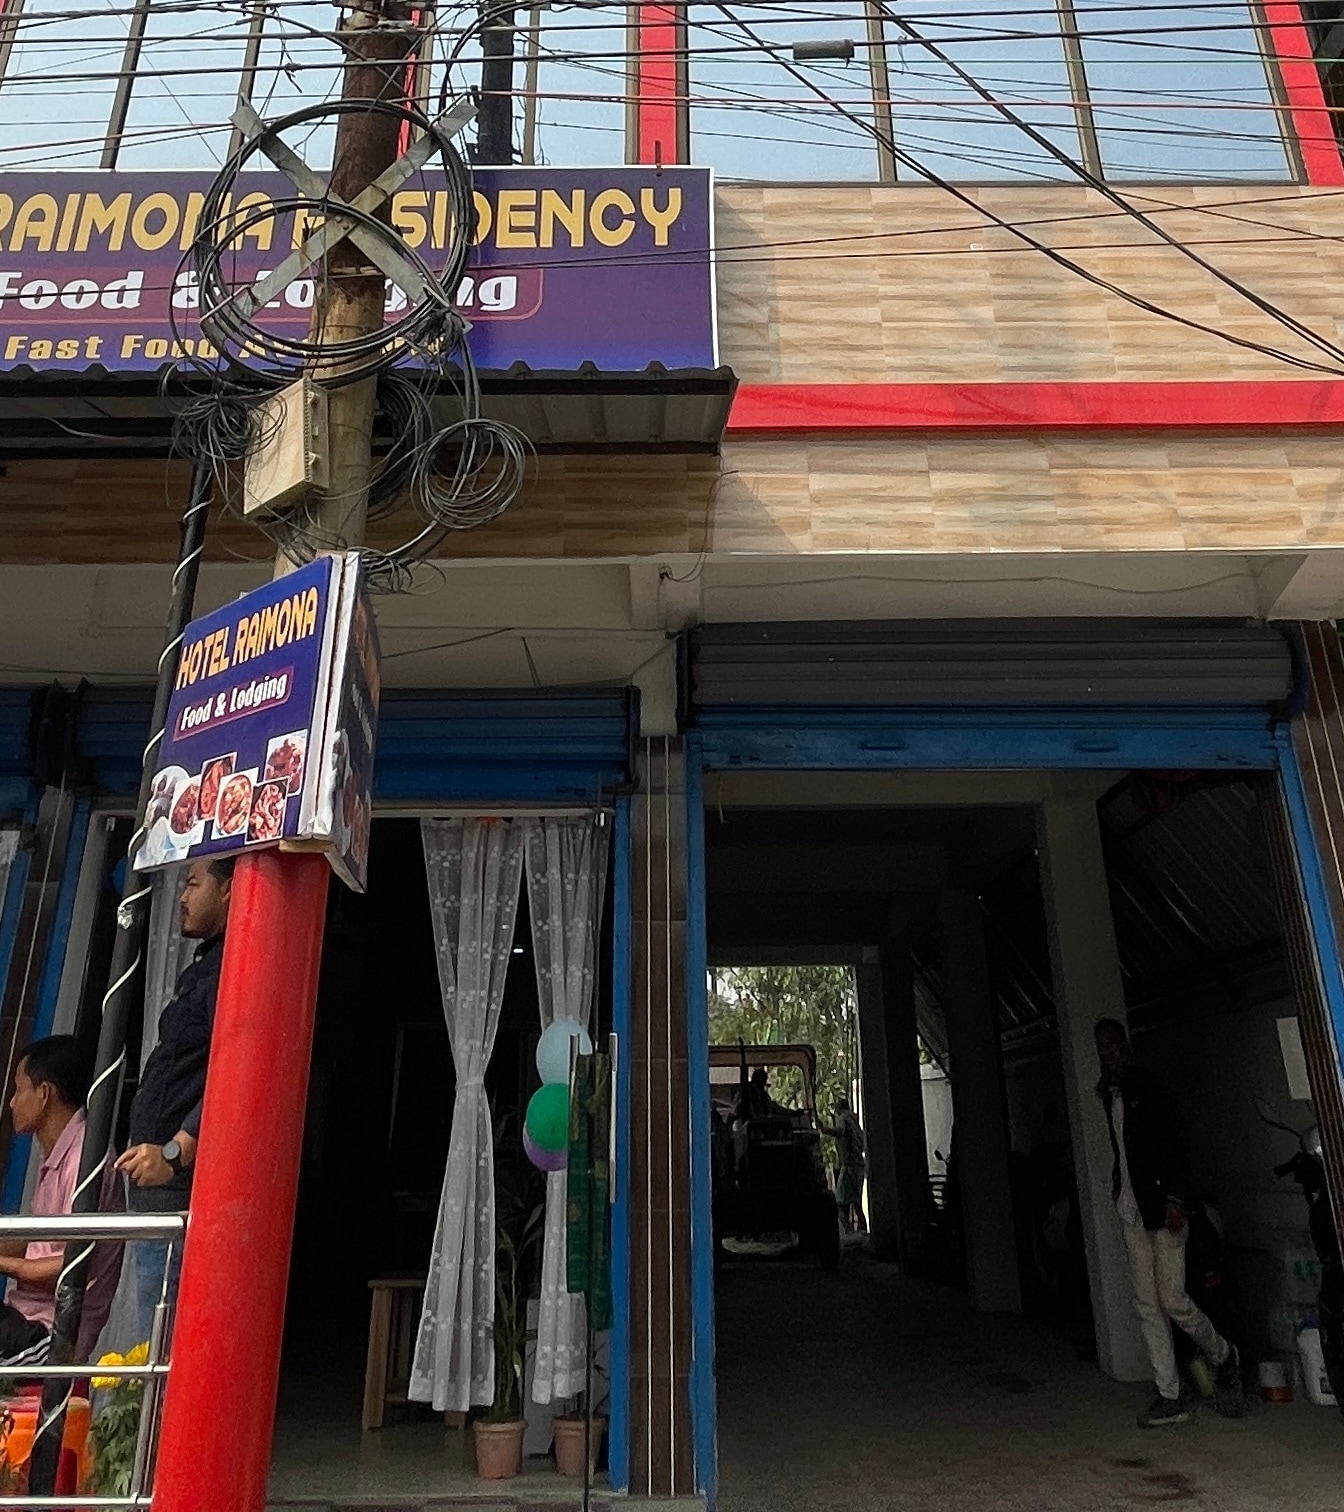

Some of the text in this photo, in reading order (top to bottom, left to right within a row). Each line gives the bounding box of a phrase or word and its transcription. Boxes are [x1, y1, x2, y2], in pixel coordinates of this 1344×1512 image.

[4, 335, 104, 360] Fast
[175, 626, 230, 691] HOTEL
[231, 586, 318, 666] RAIMONA
[180, 674, 288, 731] Food & Lodging
